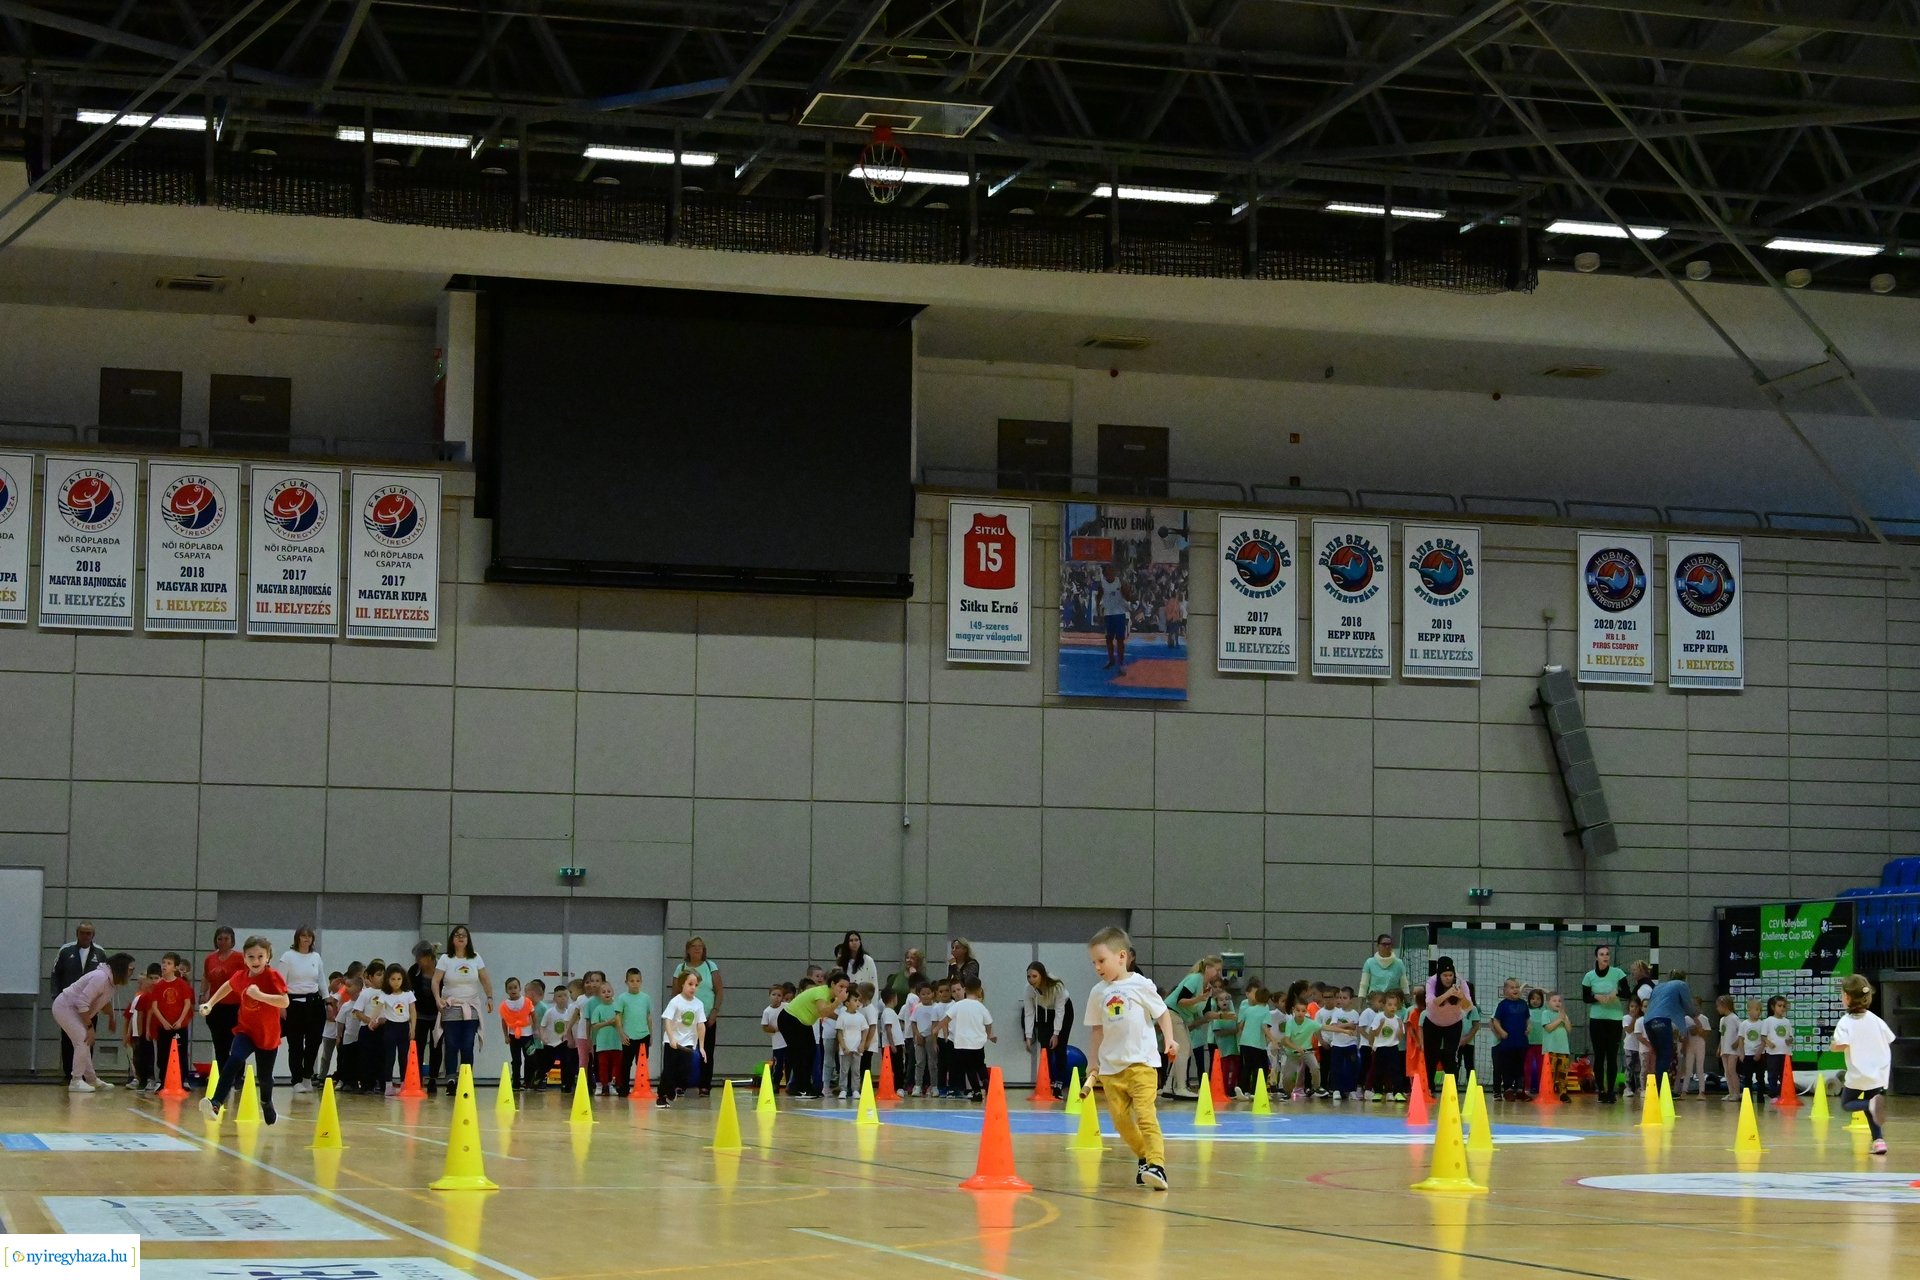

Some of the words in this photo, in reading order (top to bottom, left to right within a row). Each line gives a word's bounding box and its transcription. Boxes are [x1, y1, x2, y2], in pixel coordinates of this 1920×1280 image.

[63, 470, 105, 492] FATUM
[166, 477, 207, 499] FATUM
[268, 480, 308, 502] FATUM
[368, 487, 408, 508] FATUM
[1100, 516, 1127, 530] SITKU
[975, 525, 1005, 536] SITKU
[70, 546, 107, 554] CSAPATA
[1225, 529, 1251, 562] BLUE
[1252, 529, 1292, 568] SHARKS
[1318, 535, 1344, 567] BLUE
[1345, 534, 1384, 572] SHARKS
[174, 551, 211, 560] CSAPATA
[276, 554, 313, 562] CSAPATA
[977, 541, 1003, 573] 15
[1408, 540, 1434, 573] BLUE
[1436, 538, 1474, 576] SHARKS
[76, 560, 101, 572] 2018
[375, 560, 412, 569] CSAPATA
[180, 566, 205, 578] 2018
[282, 568, 307, 580] 2017
[49, 575, 81, 586] MAGYAR
[83, 574, 127, 588] BAJNOKSÁG
[156, 581, 198, 592] MAGYAR
[200, 582, 228, 593] KUPA
[381, 574, 406, 587] 2017
[256, 583, 287, 594] MAGYAR
[289, 583, 332, 597] BAJNOKSÁG
[358, 589, 399, 600] MAGYAR
[400, 591, 428, 602] KUPA
[49, 593, 61, 605] II.
[64, 591, 126, 608] HELYEZÉS
[156, 599, 164, 611] I.
[166, 597, 228, 613] HELYEZÉS
[960, 598, 989, 613] Sitku
[991, 601, 1019, 614] Ernő
[256, 601, 272, 613] III.
[274, 600, 331, 616] HELYEZÉS
[355, 607, 371, 619] III.
[373, 605, 429, 621] HELYEZÉS
[1247, 611, 1269, 622] 2017
[1341, 615, 1362, 627] 2018
[969, 620, 1009, 631] 149-szeres
[1233, 625, 1257, 635] HEPP
[1259, 626, 1282, 636] KUPA
[1431, 618, 1452, 630] 2019
[1594, 618, 1637, 631] 2020/2021
[955, 632, 984, 641] magyar
[985, 630, 1023, 643] válogatott
[1327, 629, 1351, 640] HEPP
[1352, 631, 1376, 641] KUPA
[1417, 632, 1441, 642] HEPP
[1442, 633, 1466, 643] KUPA
[1695, 630, 1715, 640] 2021
[1225, 641, 1237, 653] III.
[1238, 640, 1290, 655] HELYEZÉS
[1319, 646, 1331, 657] II.
[1332, 645, 1384, 659] HELYEZÉS
[1683, 643, 1706, 653] HEPP
[1707, 644, 1729, 654] KUPA
[1409, 648, 1420, 659] II.
[1422, 647, 1474, 662] HELYEZÉS
[1595, 653, 1645, 667] HELYEZÉS
[1686, 657, 1735, 671] HELYEZÉS
[1768, 919, 1780, 929] CEV
[1780, 918, 1808, 929] Volleyball
[1761, 932, 1788, 942] Challenge
[1788, 931, 1801, 942] Cup
[1801, 931, 1815, 940] 2024
